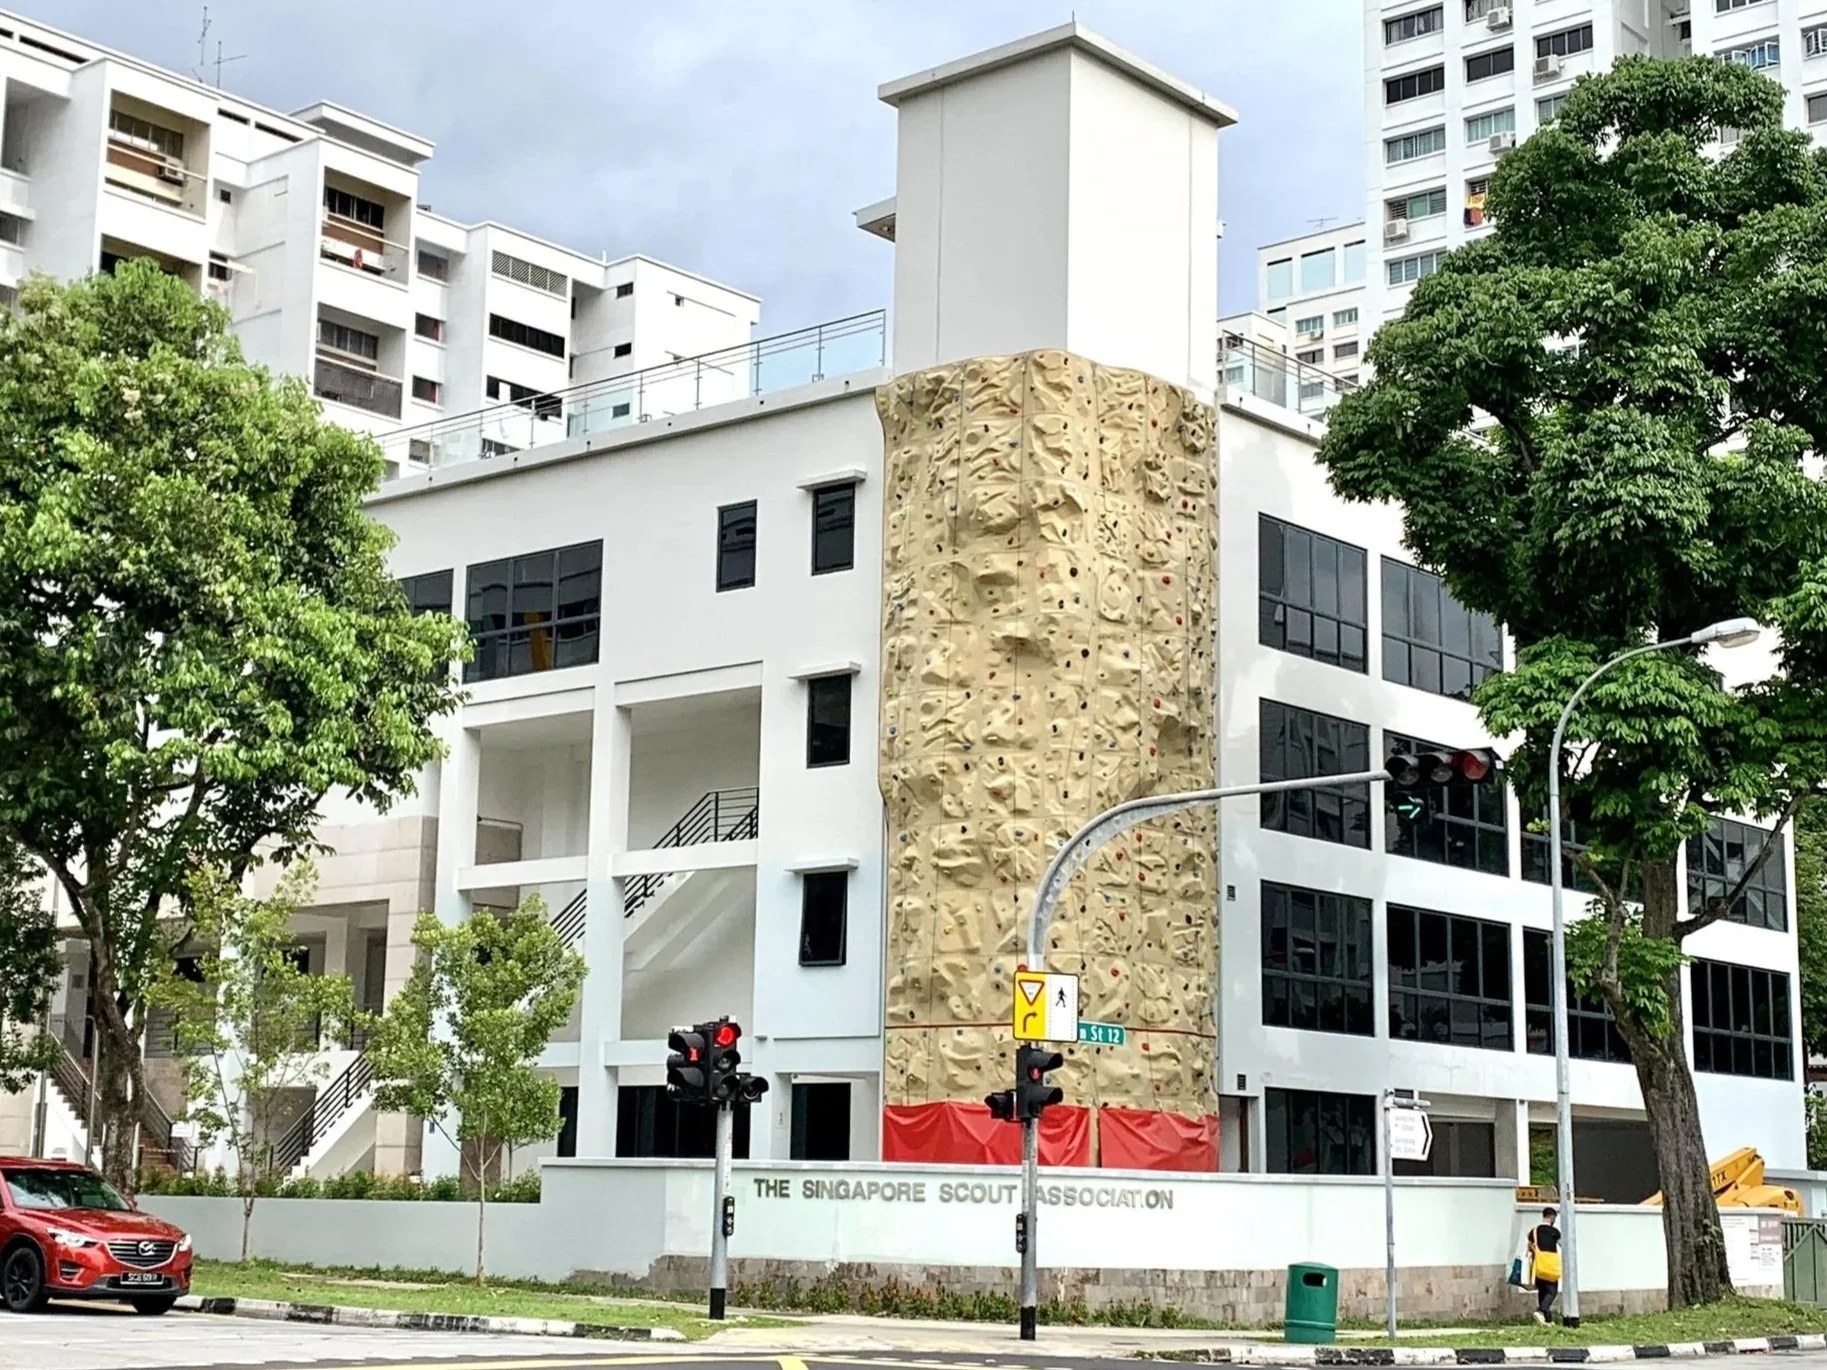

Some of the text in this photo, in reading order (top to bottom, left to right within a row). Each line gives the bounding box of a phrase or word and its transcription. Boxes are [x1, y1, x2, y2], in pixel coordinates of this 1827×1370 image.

[1090, 1025, 1104, 1041] St
[1107, 1028, 1120, 1043] 12
[753, 1178, 1174, 1209] THE SINGAPORE SCOUT ASSOCIATION
